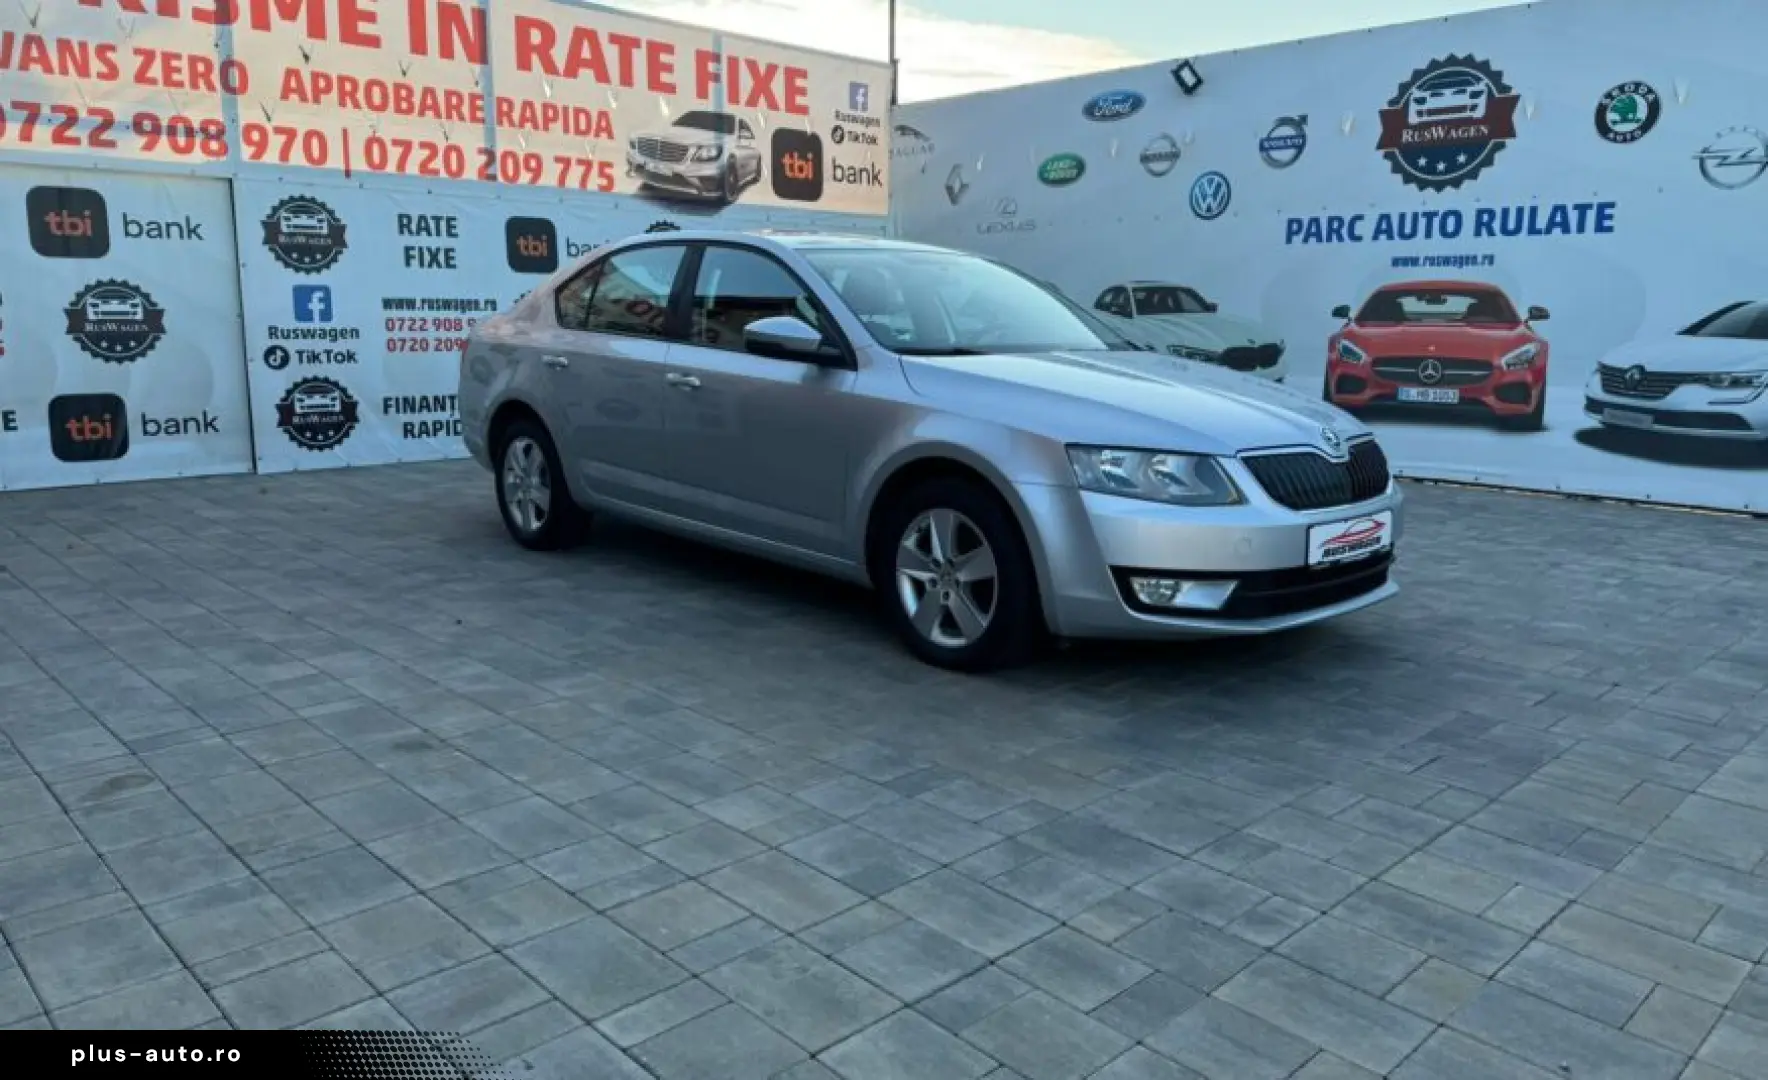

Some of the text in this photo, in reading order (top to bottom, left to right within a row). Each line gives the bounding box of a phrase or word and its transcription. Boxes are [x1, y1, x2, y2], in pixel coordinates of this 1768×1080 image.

[408, 0, 489, 65] IN
[514, 15, 677, 95] RATE
[695, 48, 809, 116] FIXE
[132, 47, 249, 95] ZERO
[280, 67, 485, 124] APROBARE
[496, 96, 615, 140] RAPIDA
[132, 112, 229, 158] 908
[242, 122, 328, 166] 970
[364, 135, 466, 179] 0720
[477, 146, 543, 185] 209
[554, 156, 615, 192] 775
[782, 152, 883, 187] tbi bank
[44, 209, 204, 241] tbi bank
[397, 213, 458, 238] RATE
[1285, 202, 1617, 245] PARC AUTO RULATE
[404, 247, 457, 270] FIXE
[517, 235, 548, 258] tbi
[1390, 253, 1496, 269] www.ruswagen.ro
[268, 326, 360, 343] Ruswagen
[385, 317, 428, 332] 0722
[432, 317, 463, 332] 908
[387, 337, 429, 352] 0720
[295, 349, 358, 366] TikTok
[65, 411, 220, 441] tbi bank
[403, 420, 462, 438] RAPID
